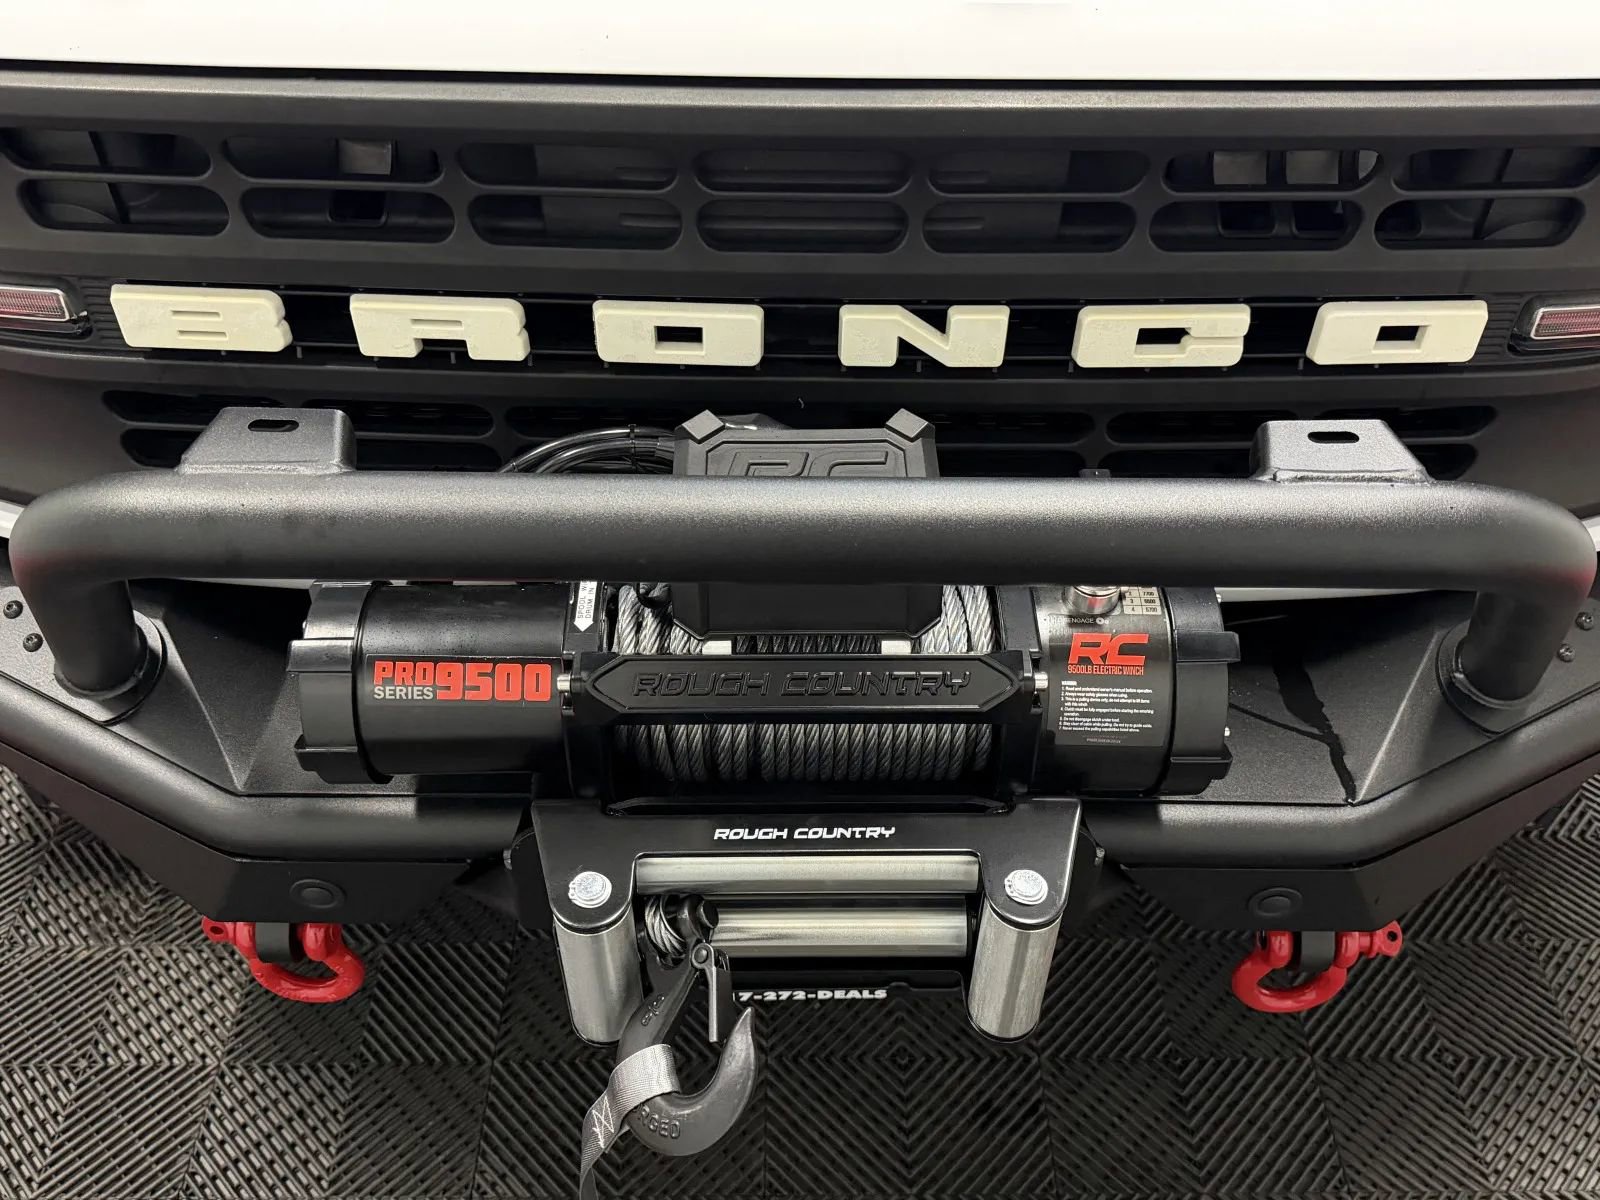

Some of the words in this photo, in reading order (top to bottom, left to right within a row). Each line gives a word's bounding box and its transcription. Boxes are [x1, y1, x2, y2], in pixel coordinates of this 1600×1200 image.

[110, 284, 1488, 368] BRONCO
[1068, 633, 1149, 666] RC
[1068, 664, 1093, 674] 9500LB
[1093, 665, 1123, 675] ELECTRIC
[1123, 665, 1144, 675] WINCH
[374, 661, 435, 686] PRO
[436, 662, 552, 701] 9500
[632, 671, 771, 698] ROUGH
[780, 670, 971, 697] COUNTRY
[374, 686, 433, 699] SERIES
[713, 827, 789, 841] ROUGH
[794, 826, 896, 840] COUNTRY
[733, 988, 888, 1003] 7-272-DEALS
